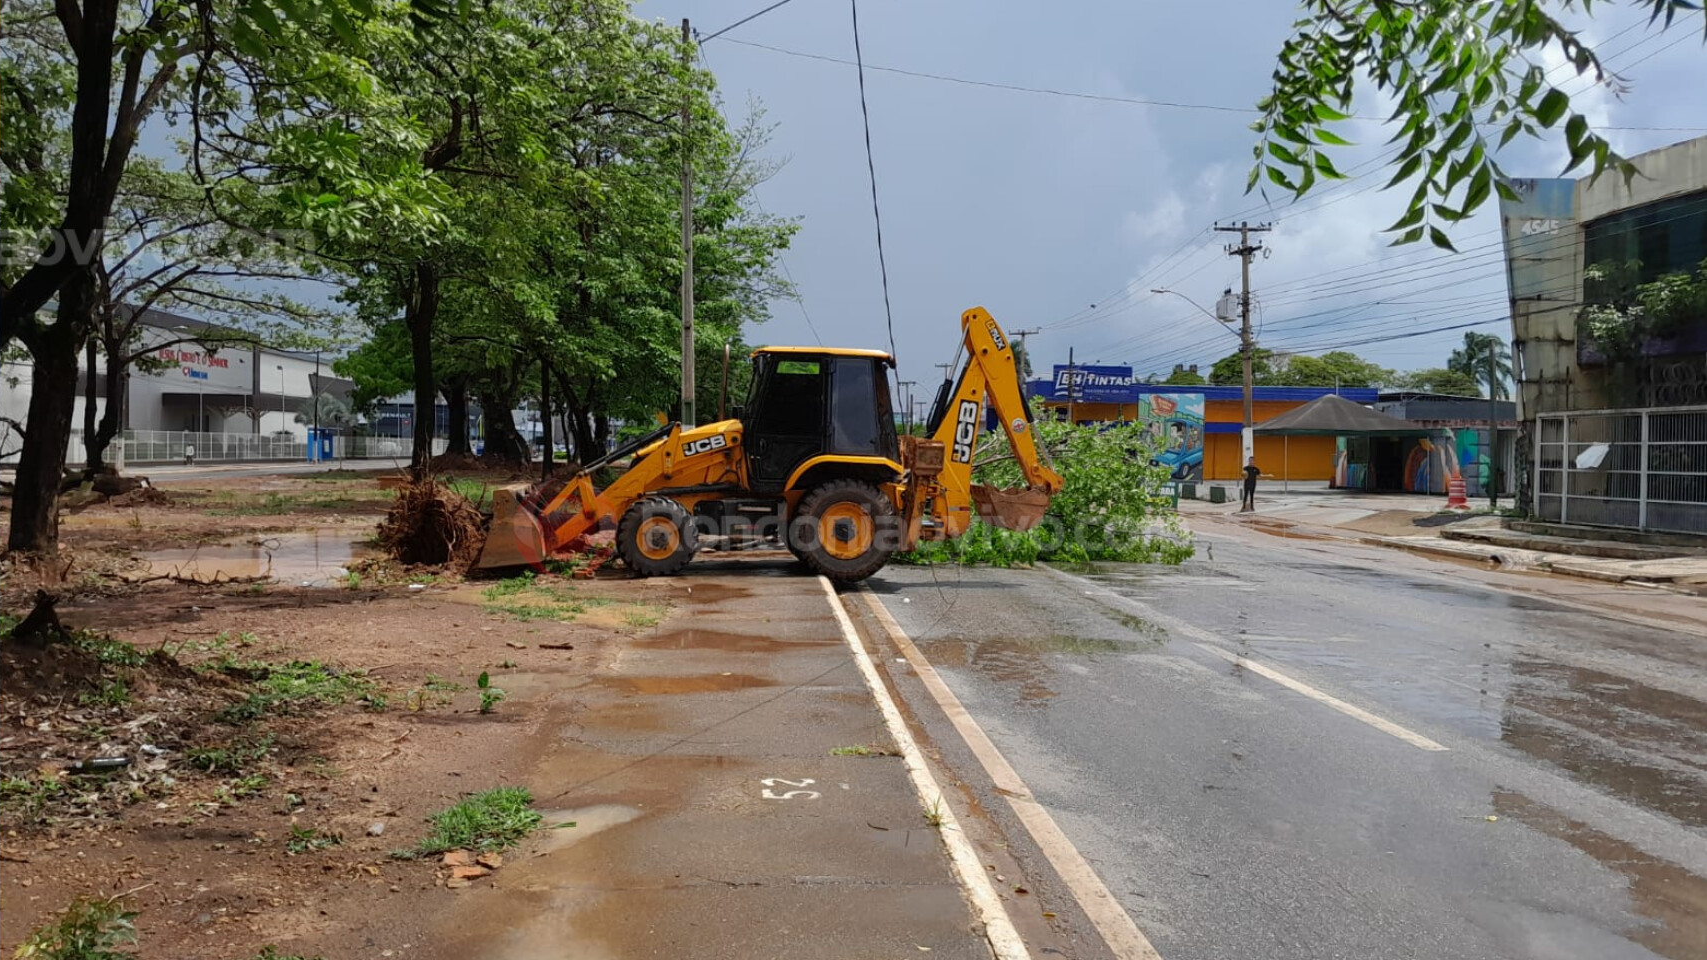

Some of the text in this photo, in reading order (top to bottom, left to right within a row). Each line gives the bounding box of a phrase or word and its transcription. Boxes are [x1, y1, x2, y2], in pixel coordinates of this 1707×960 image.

[1088, 371, 1132, 386] TINTAS
[954, 401, 978, 463] JCB
[684, 435, 725, 456] JCB
